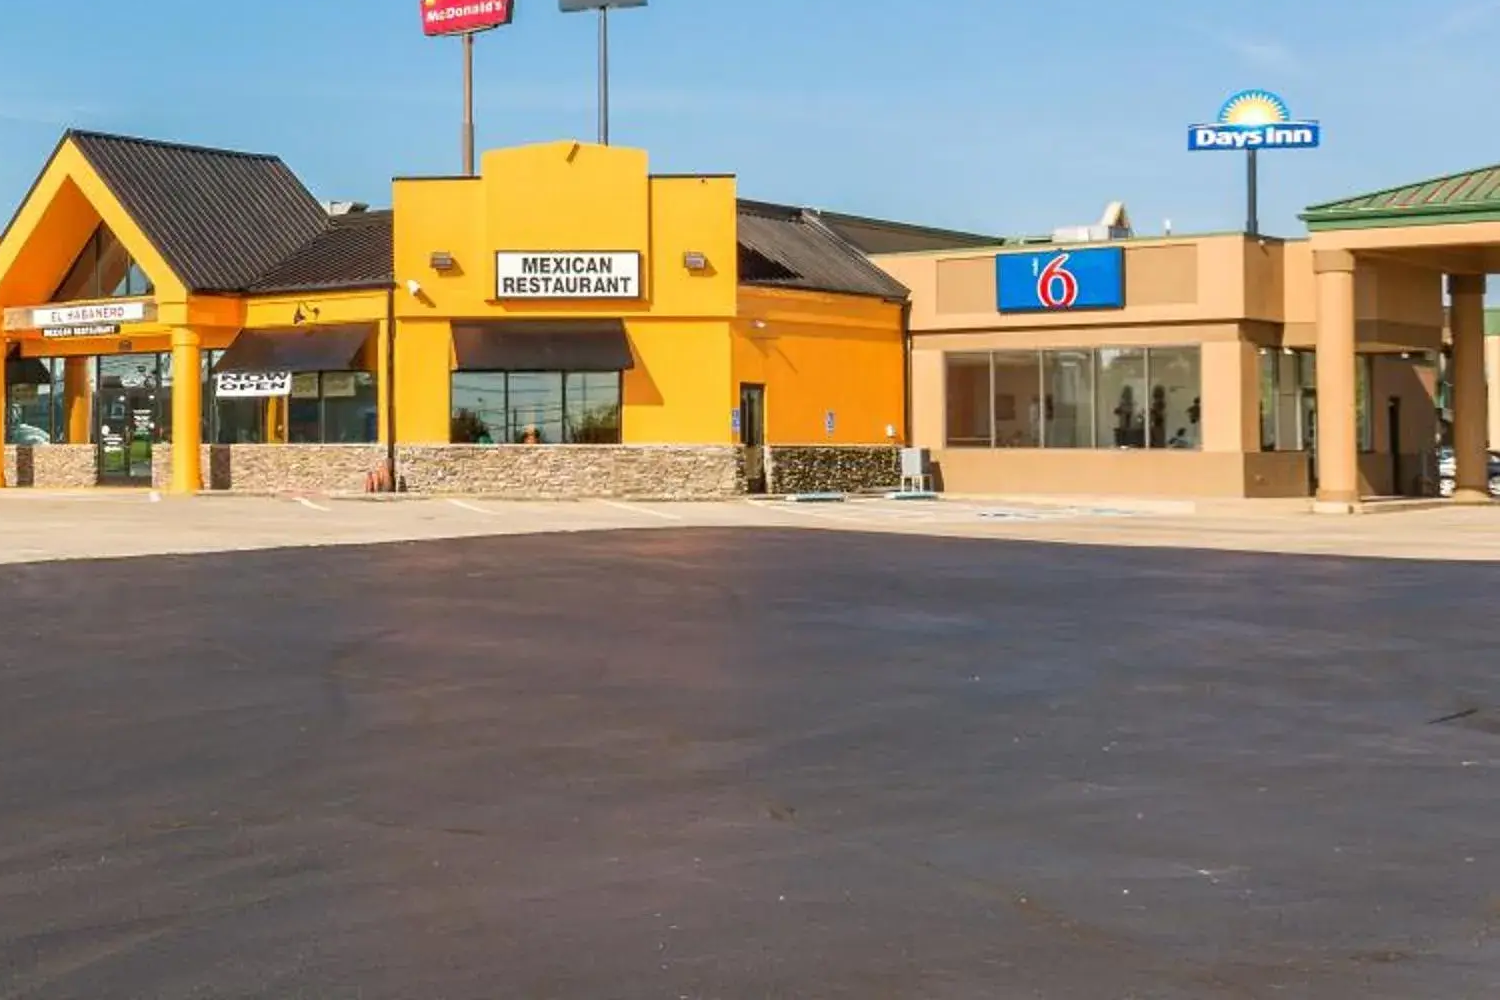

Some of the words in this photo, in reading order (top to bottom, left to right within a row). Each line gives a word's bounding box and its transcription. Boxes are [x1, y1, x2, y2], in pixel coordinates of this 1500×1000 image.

[426, 0, 503, 22] McDonald's
[1197, 129, 1263, 147] Days
[1265, 127, 1312, 143] Inn
[521, 257, 613, 274] MEXICAN
[502, 276, 632, 293] RESTAURANT
[1037, 253, 1078, 309] 6
[51, 311, 63, 322] EL
[68, 306, 125, 321] HABANERO
[220, 370, 288, 381] NOW
[220, 381, 286, 391] OPEN
